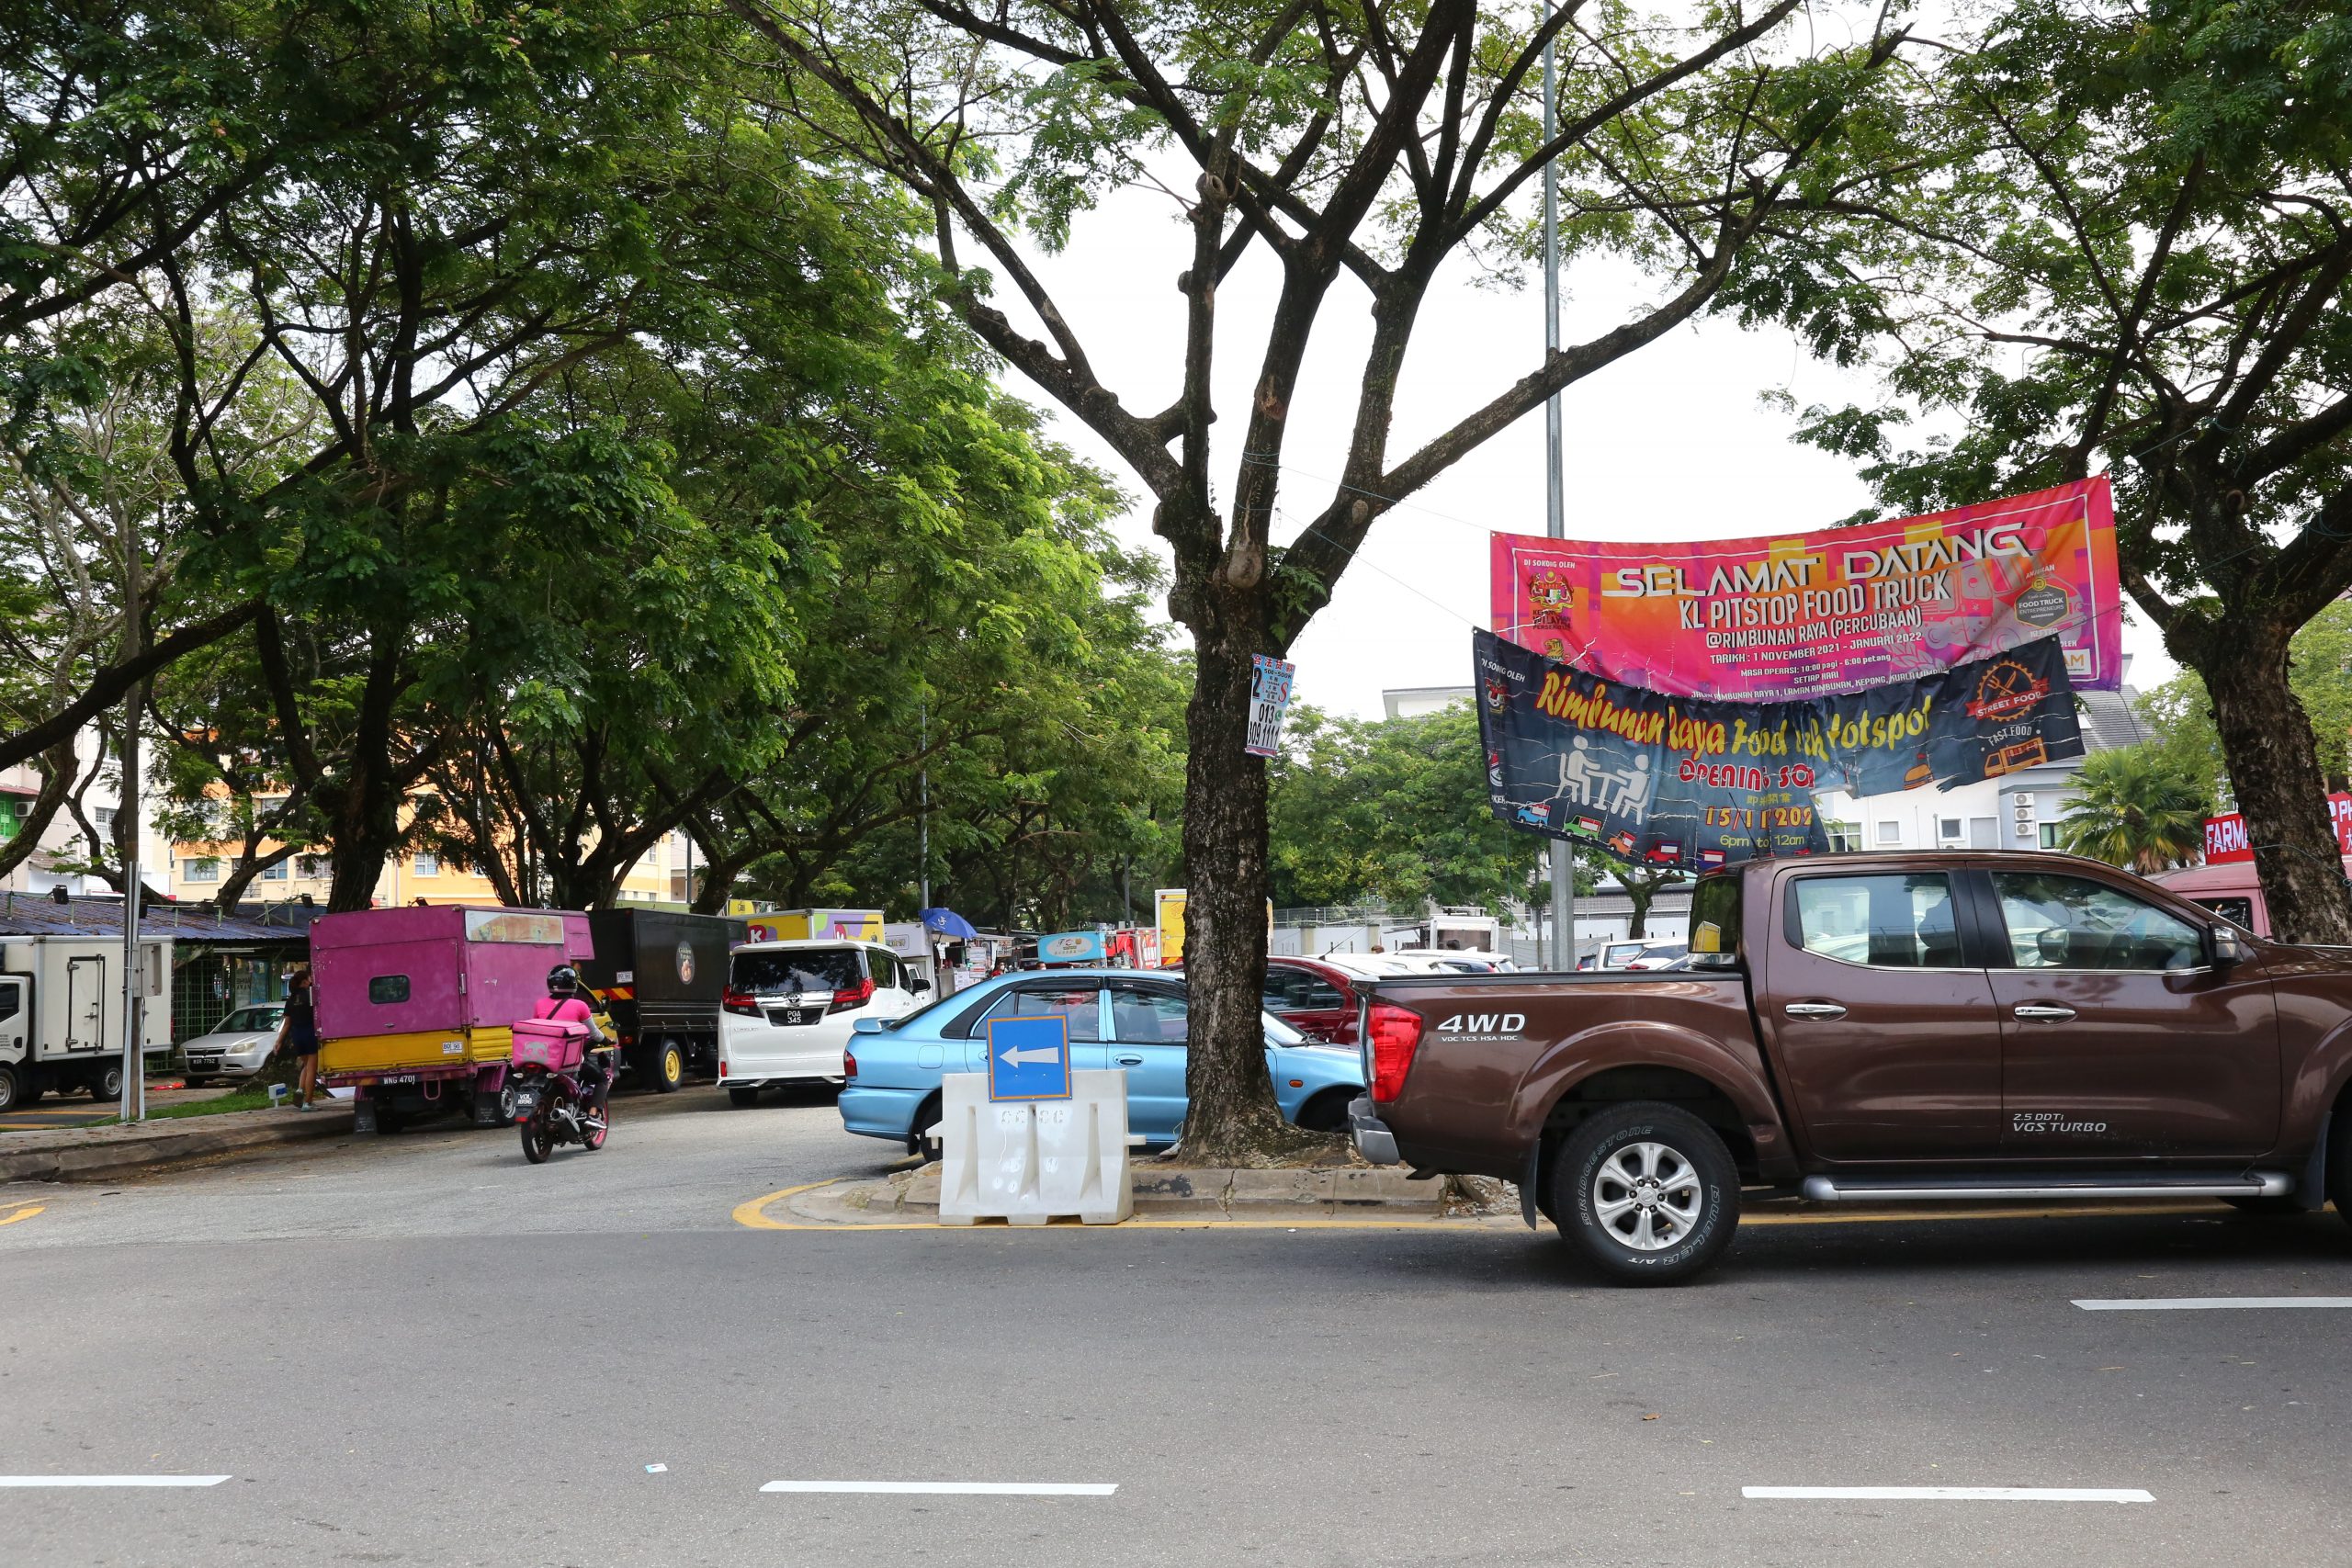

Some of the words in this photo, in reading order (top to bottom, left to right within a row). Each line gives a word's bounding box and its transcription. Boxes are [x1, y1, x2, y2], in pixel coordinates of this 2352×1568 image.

[1601, 557, 1819, 598] SELAMAT
[1843, 522, 2032, 581] DATANG
[1679, 599, 1706, 630] KL
[1711, 592, 1800, 629] PITSTOP
[1804, 583, 1866, 620] FOOD
[1869, 569, 1951, 611] TRUCK
[2018, 600, 2040, 609] FOOD
[2040, 597, 2064, 605] TRUCK
[1705, 627, 1796, 649] @RIMBUNAN
[1798, 621, 1828, 643] RAYA
[1830, 605, 1924, 639] (PERCUBAAN)
[1710, 653, 1746, 664] TARIKH
[1761, 647, 1815, 661] NOVEMBER
[1818, 643, 1840, 654] 2021
[1849, 634, 1894, 649] JANUARI
[1895, 631, 1922, 643] 2022
[1506, 670, 1526, 682] OLEH
[1740, 668, 1763, 677] MASA
[1801, 663, 1821, 672] 10:00
[1822, 660, 1838, 671] pagi
[1844, 657, 1861, 667] 6:00
[1862, 654, 1892, 666] petang
[1793, 674, 1820, 684] SETIAP
[1821, 671, 1839, 681] HARI
[1783, 685, 1810, 695] LAMAN
[1259, 703, 1275, 724] 013
[1535, 671, 1666, 745] Rimbunan
[1977, 699, 2010, 716] STREET
[2014, 691, 2041, 705] FOOD
[1988, 728, 2008, 747] FAST
[2009, 726, 2032, 736] FOOD
[1720, 834, 1750, 848] 6pm
[1756, 837, 1770, 848] to
[1774, 834, 1805, 846] 12am
[1437, 1013, 1526, 1032] 4WD
[383, 1076, 398, 1085] WNG
[399, 1075, 415, 1086] 4701
[2013, 1122, 2047, 1132] VGS
[2050, 1122, 2107, 1132] TURBO
[2034, 1112, 2064, 1121] DDTi
[1577, 1125, 1654, 1226] BRIDGESTONE
[1663, 1184, 1720, 1266] DUELER
[1627, 1257, 1657, 1265] A/T
